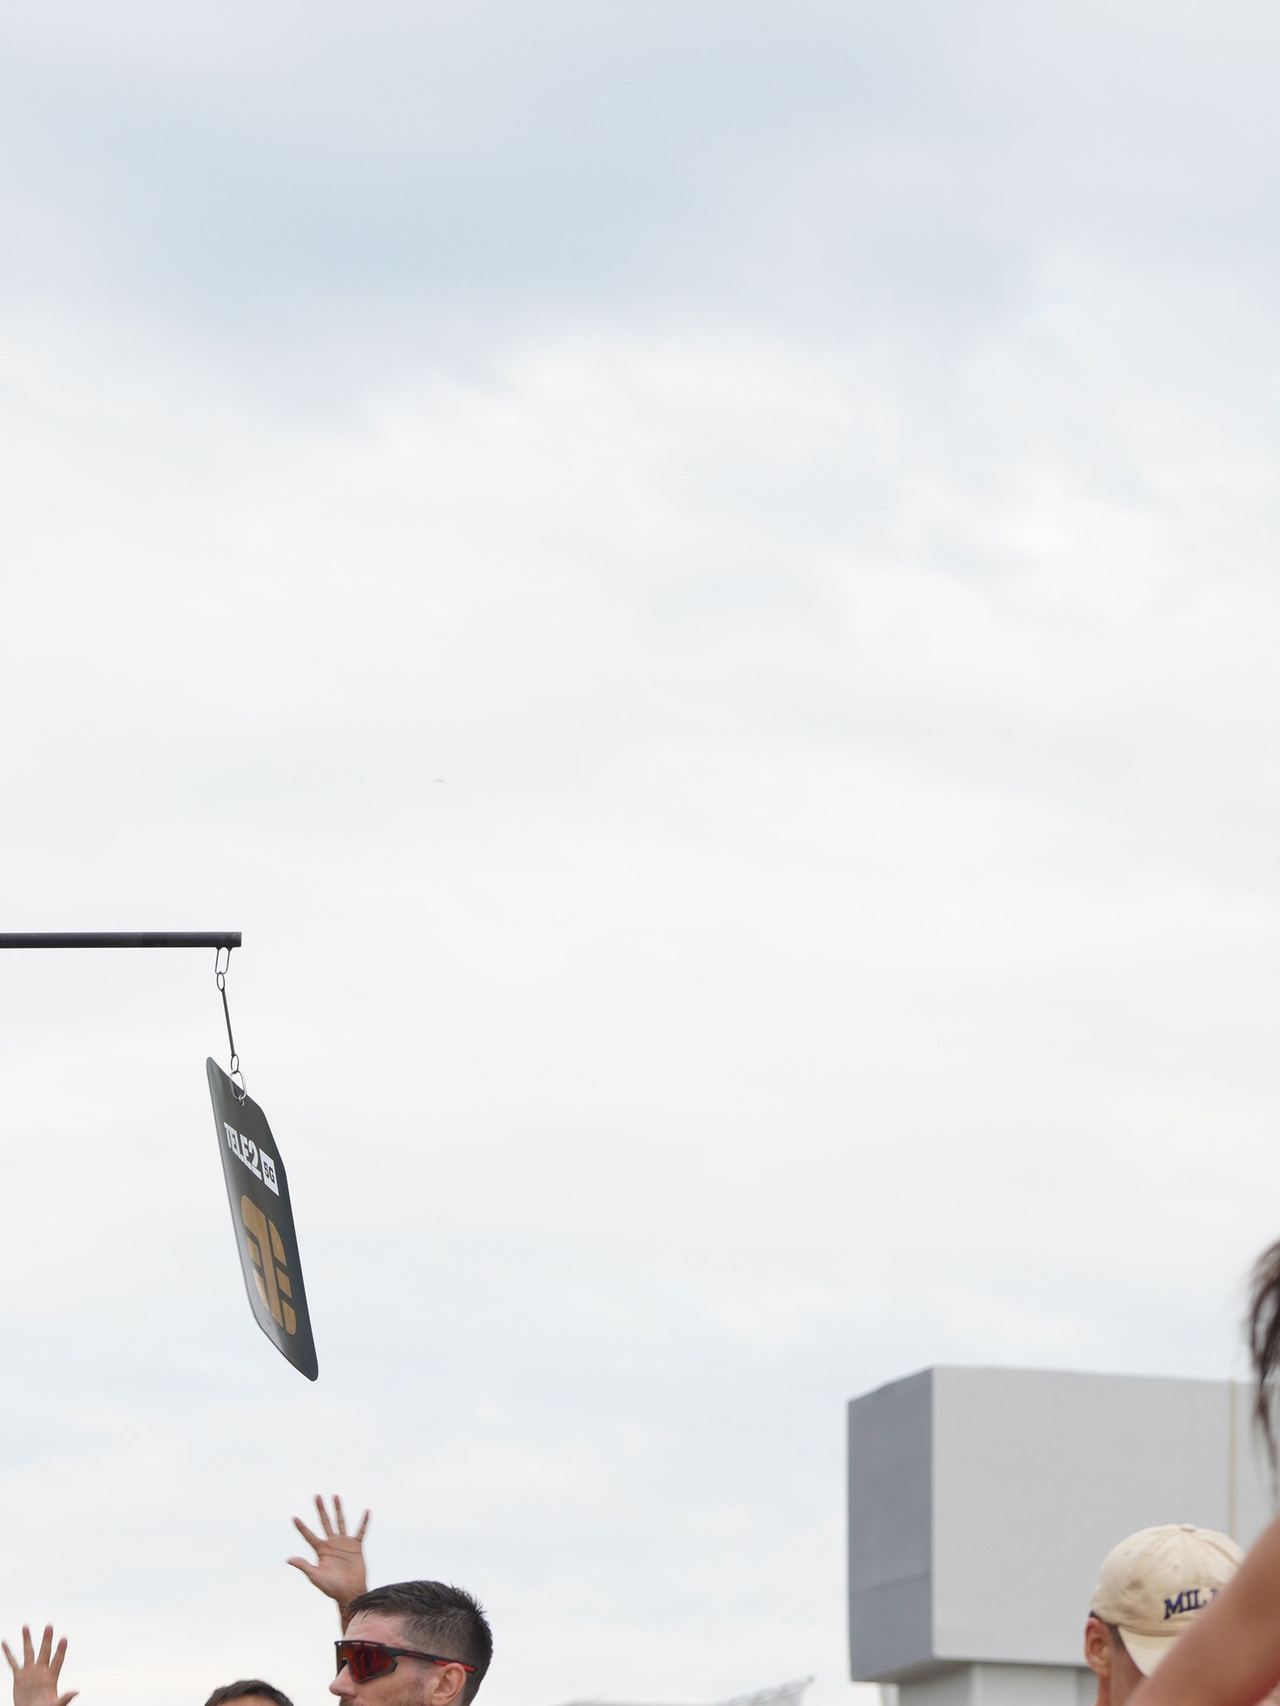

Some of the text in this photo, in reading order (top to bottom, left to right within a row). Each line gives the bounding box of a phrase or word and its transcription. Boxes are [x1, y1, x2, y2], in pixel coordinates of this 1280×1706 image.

[223, 1121, 276, 1185] TELE2 5G
[164, 1588, 219, 1620] MIL
